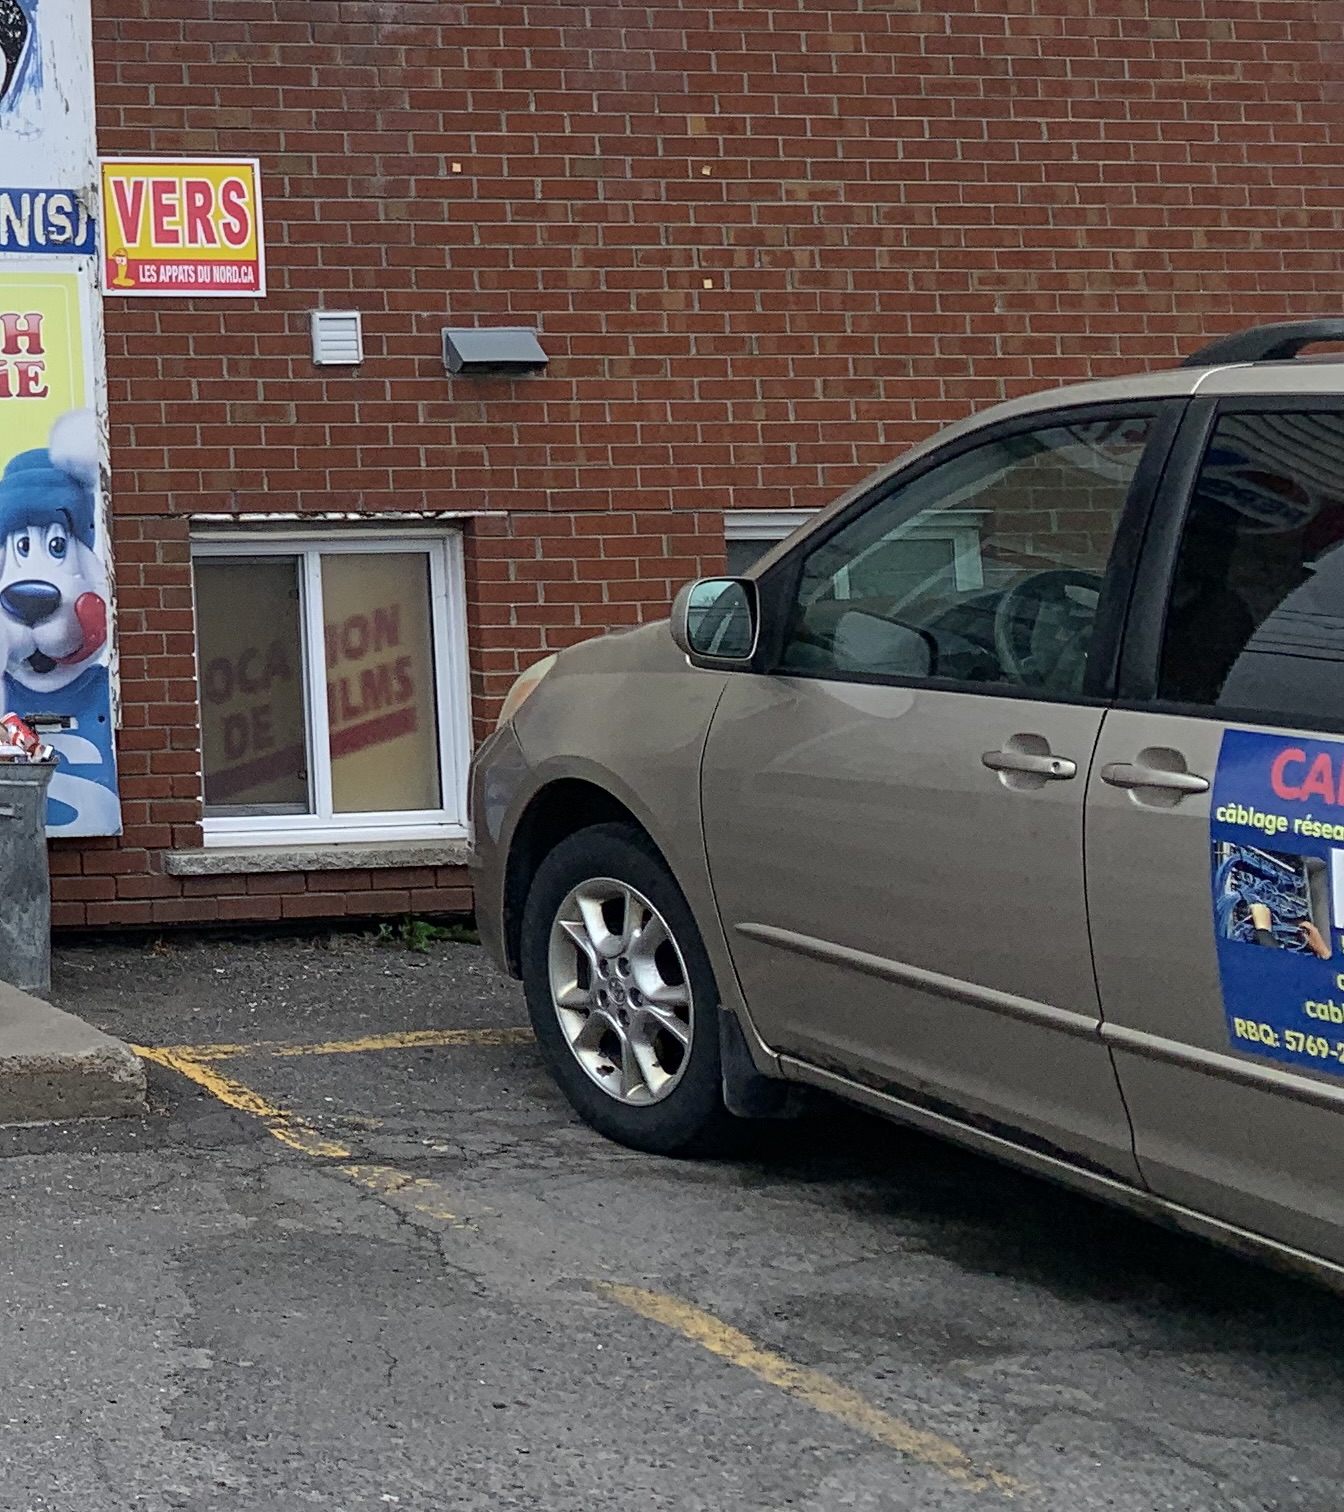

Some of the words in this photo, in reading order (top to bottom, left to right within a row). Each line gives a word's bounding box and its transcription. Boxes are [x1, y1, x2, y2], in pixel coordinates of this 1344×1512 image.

[109, 176, 252, 249] VERS
[139, 264, 157, 283] LES
[159, 264, 196, 284] APPATS
[197, 265, 211, 283] DU
[212, 265, 255, 284] NORD.CA
[1271, 746, 1344, 807] CA
[1216, 802, 1289, 836] câblage
[1234, 1017, 1281, 1048] RBQ:
